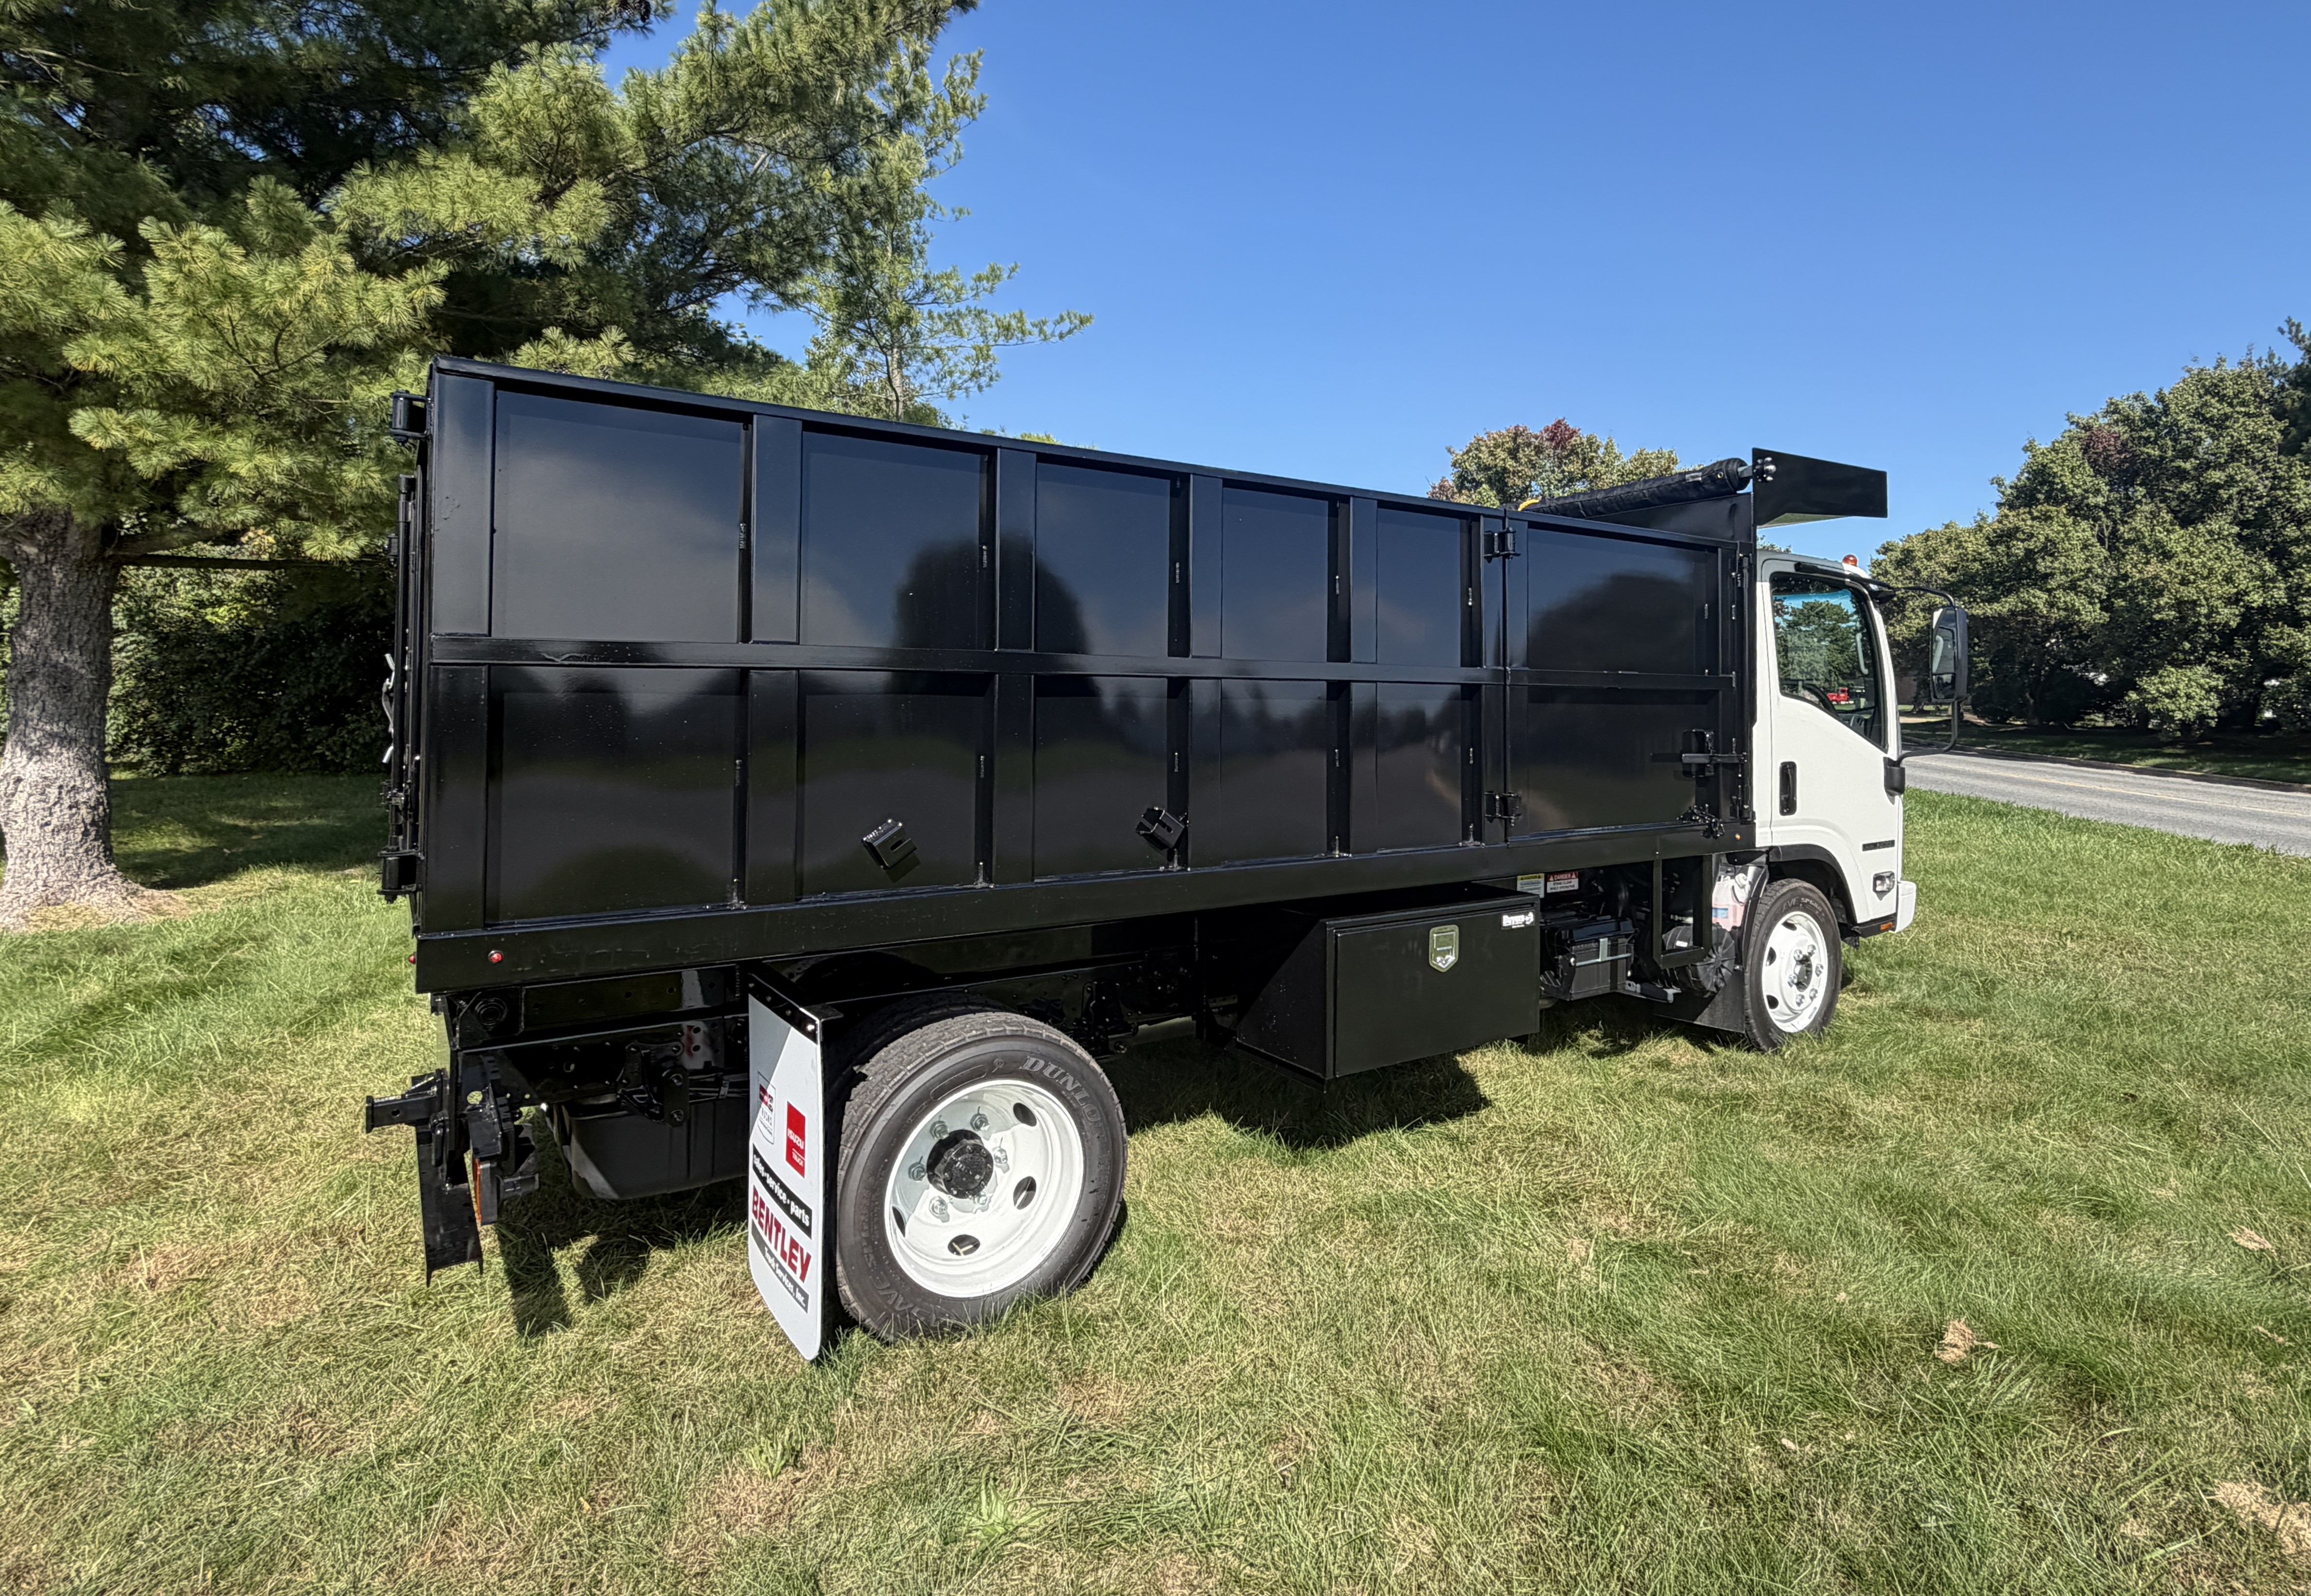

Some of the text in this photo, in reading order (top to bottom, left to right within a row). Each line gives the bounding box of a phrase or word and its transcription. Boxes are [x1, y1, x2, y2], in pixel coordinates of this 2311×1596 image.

[787, 1128, 804, 1150] ISUZU
[792, 1151, 804, 1167] TRUCK
[752, 1184, 812, 1284] BENTLEY
[764, 1246, 776, 1270] Truck
